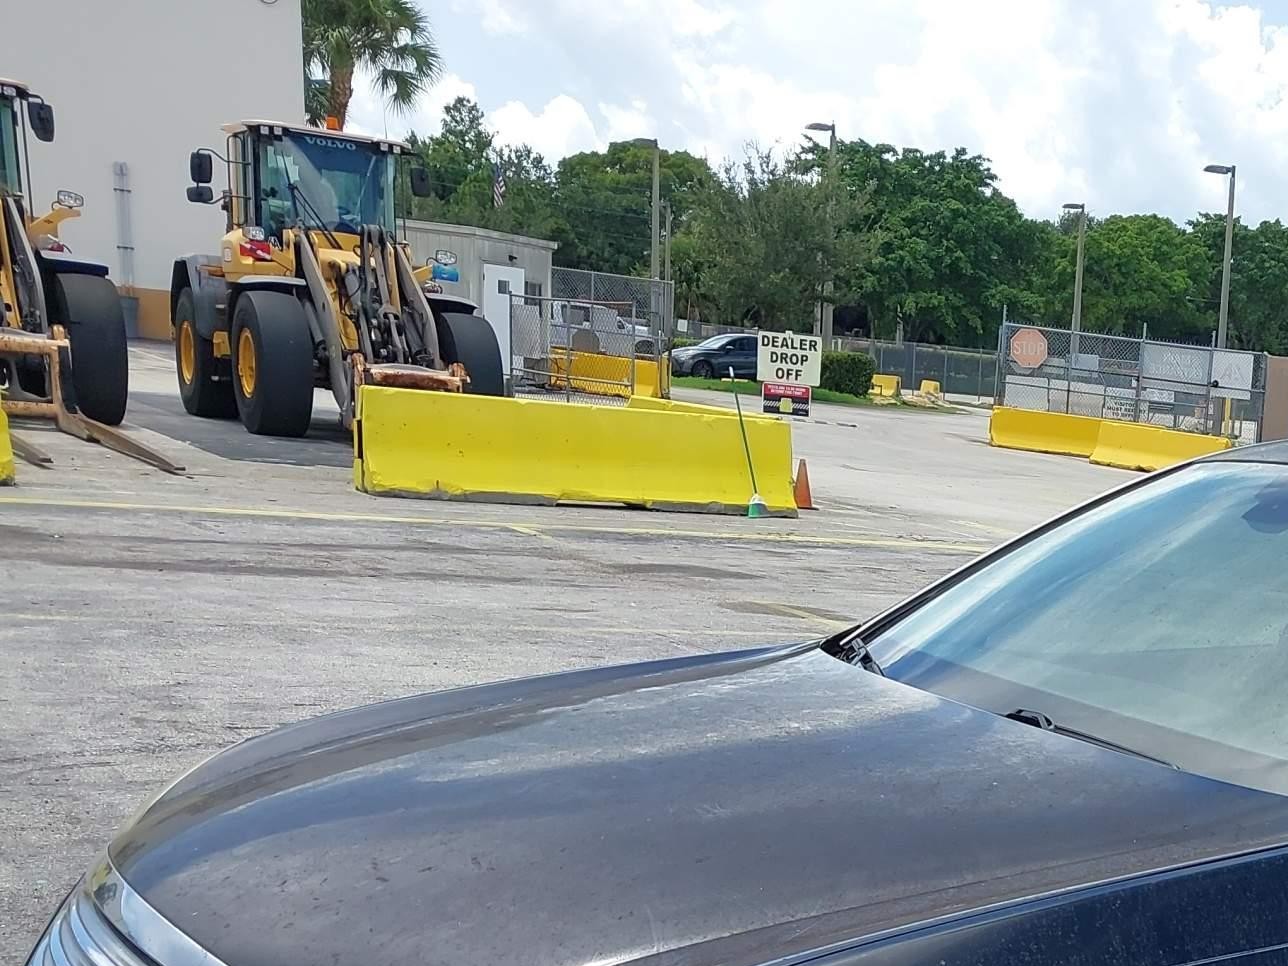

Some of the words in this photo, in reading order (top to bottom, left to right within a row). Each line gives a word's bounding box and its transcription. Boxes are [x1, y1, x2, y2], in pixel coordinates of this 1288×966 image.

[304, 136, 356, 150] VOLVO
[761, 335, 818, 352] DEALER
[1013, 341, 1045, 355] STOP
[770, 351, 808, 366] DROP
[775, 367, 803, 381] OFF
